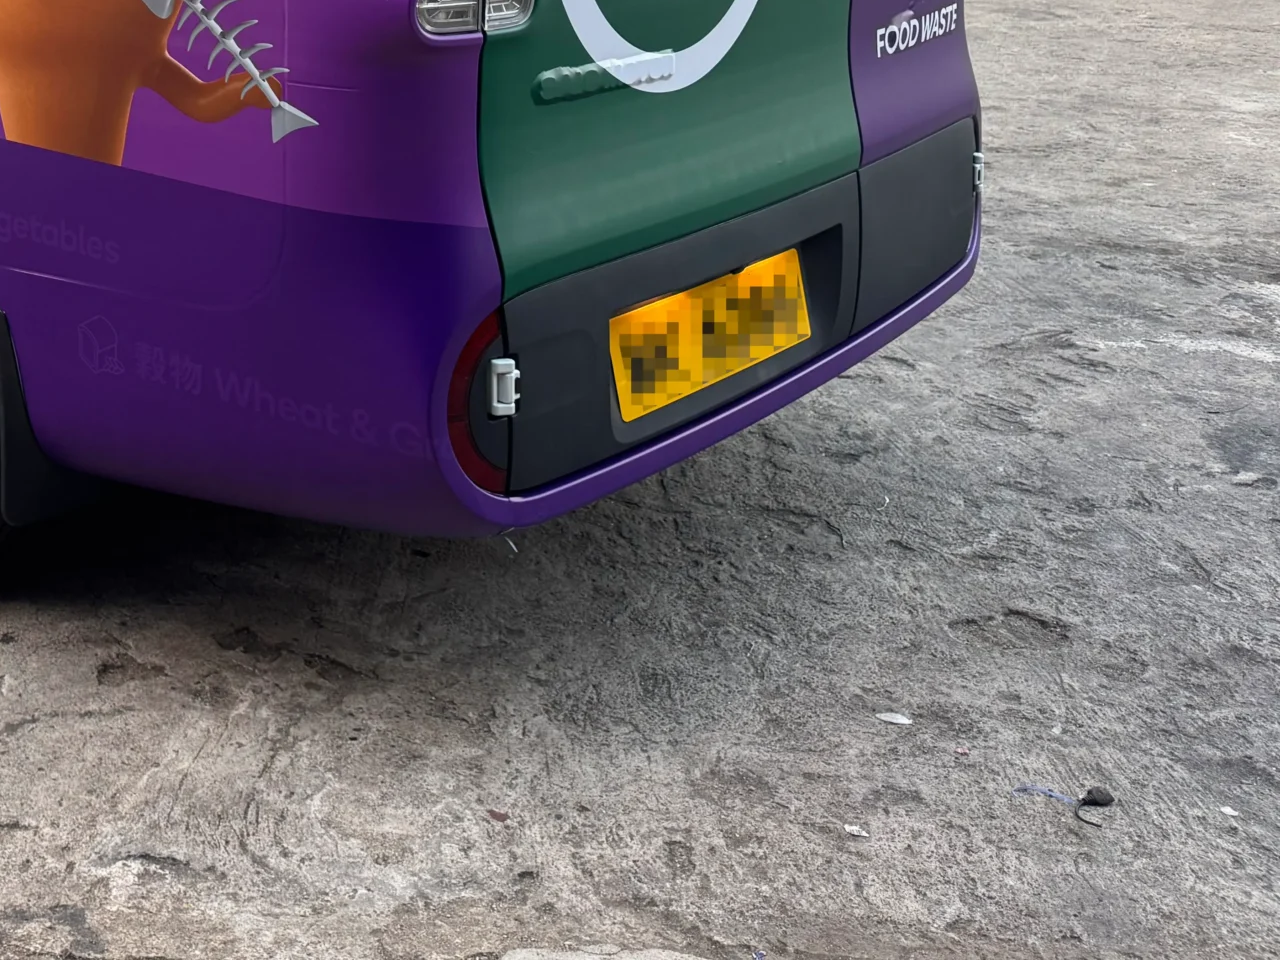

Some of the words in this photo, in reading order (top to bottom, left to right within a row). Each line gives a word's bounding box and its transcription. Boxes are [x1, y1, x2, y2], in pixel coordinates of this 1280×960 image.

[877, 18, 920, 58] FOOD
[920, 3, 958, 43] WASTE
[213, 366, 340, 435] Wheat
[349, 409, 379, 447] &
